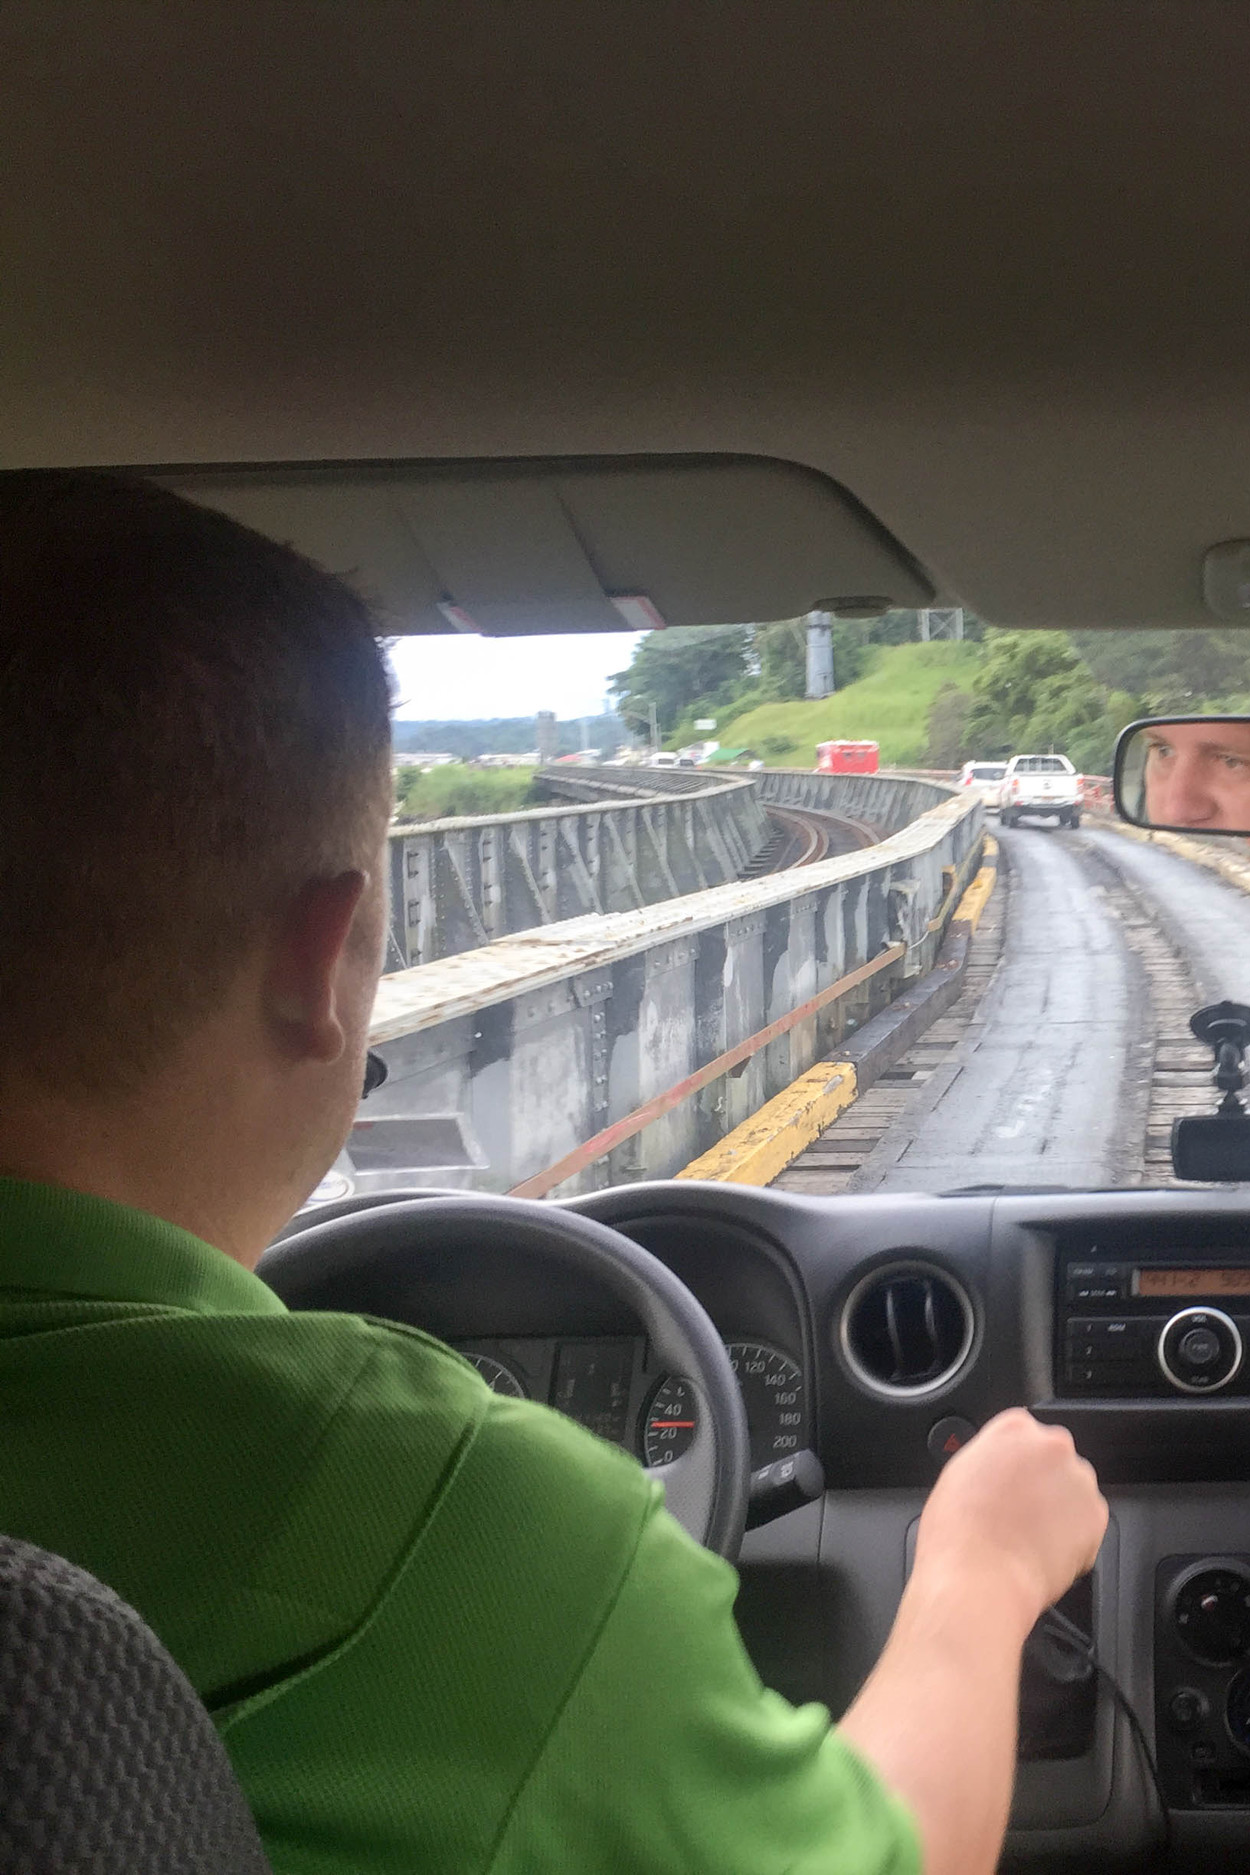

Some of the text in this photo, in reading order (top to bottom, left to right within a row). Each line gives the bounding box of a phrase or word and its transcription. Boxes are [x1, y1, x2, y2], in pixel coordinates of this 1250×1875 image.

[765, 1374, 786, 1386] 140
[664, 1403, 682, 1416] 40
[779, 1412, 801, 1425] 180
[660, 1427, 678, 1440] 20
[773, 1435, 798, 1448] 200
[664, 1450, 674, 1462] 0
